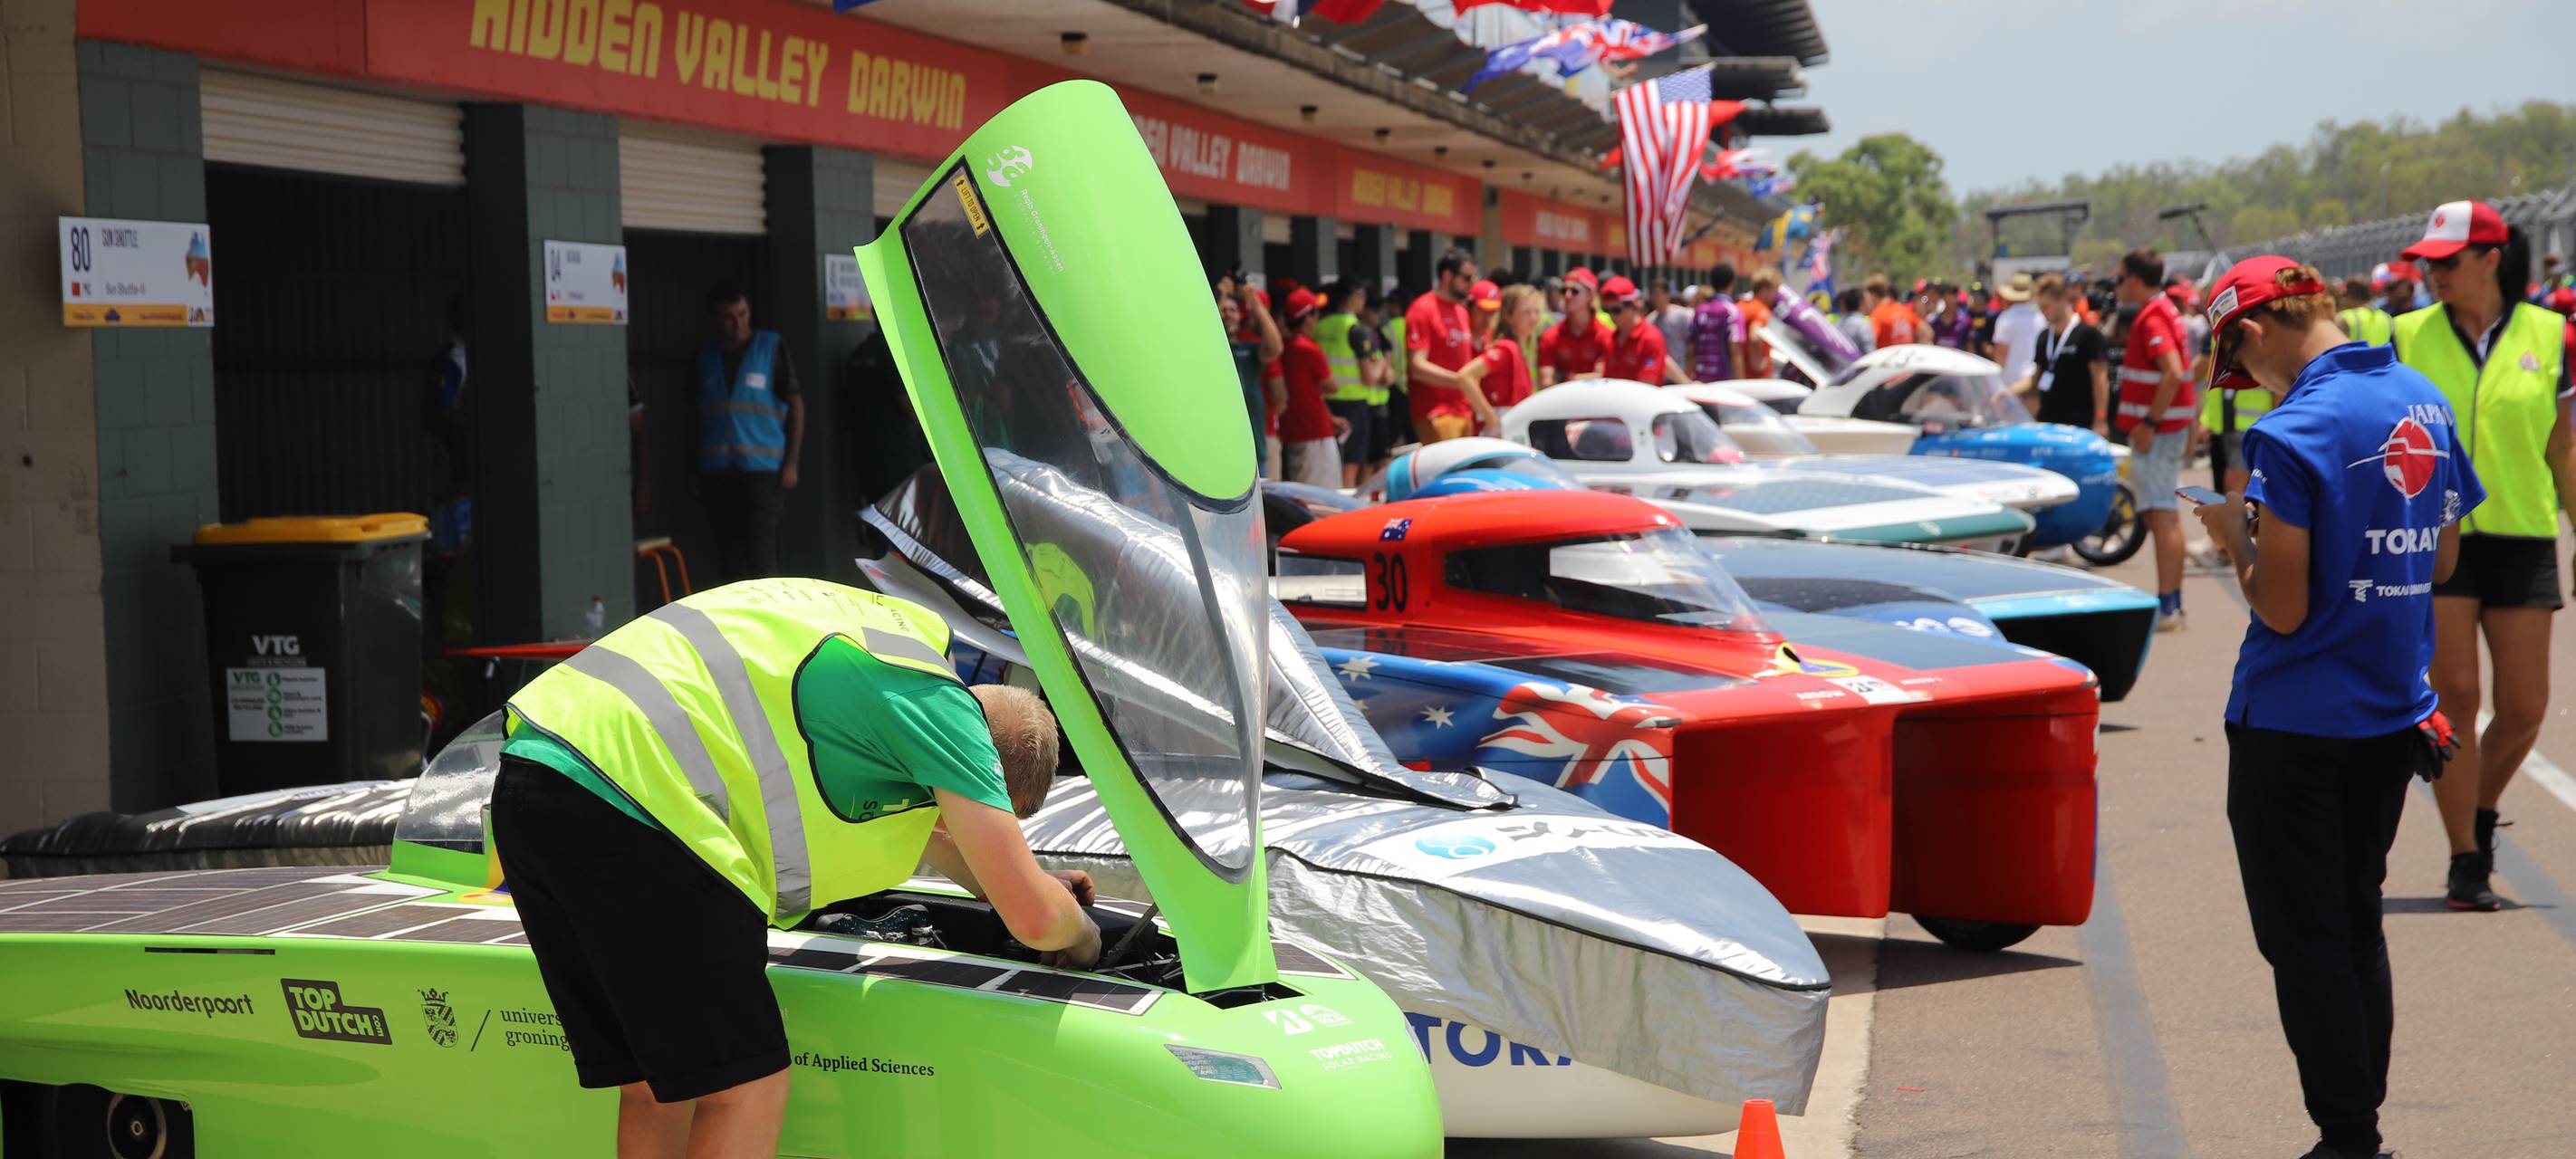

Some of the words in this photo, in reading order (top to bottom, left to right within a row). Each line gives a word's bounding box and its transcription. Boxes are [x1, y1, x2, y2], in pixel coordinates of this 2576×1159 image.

[470, 0, 663, 79] HIDDEN
[675, 11, 829, 107] VALLEY
[847, 51, 966, 129] DARWIN
[1169, 123, 1232, 179] VALLEY
[1235, 141, 1290, 191] DARWIN
[960, 186, 971, 200] LIFT
[970, 206, 980, 223] OPEN
[71, 225, 91, 272] 80
[2365, 526, 2442, 555] TORAY
[1372, 552, 1408, 613] 30
[252, 636, 300, 655] VTG
[232, 671, 261, 684] VTG
[124, 989, 255, 1019] Noorderpoort
[288, 986, 337, 1012] TOP
[298, 1009, 371, 1037] DUTCH
[1309, 1038, 1386, 1061] TOPDUTCH
[794, 1052, 810, 1067] of
[812, 1053, 867, 1073] Applied
[871, 1058, 935, 1077] Sciences
